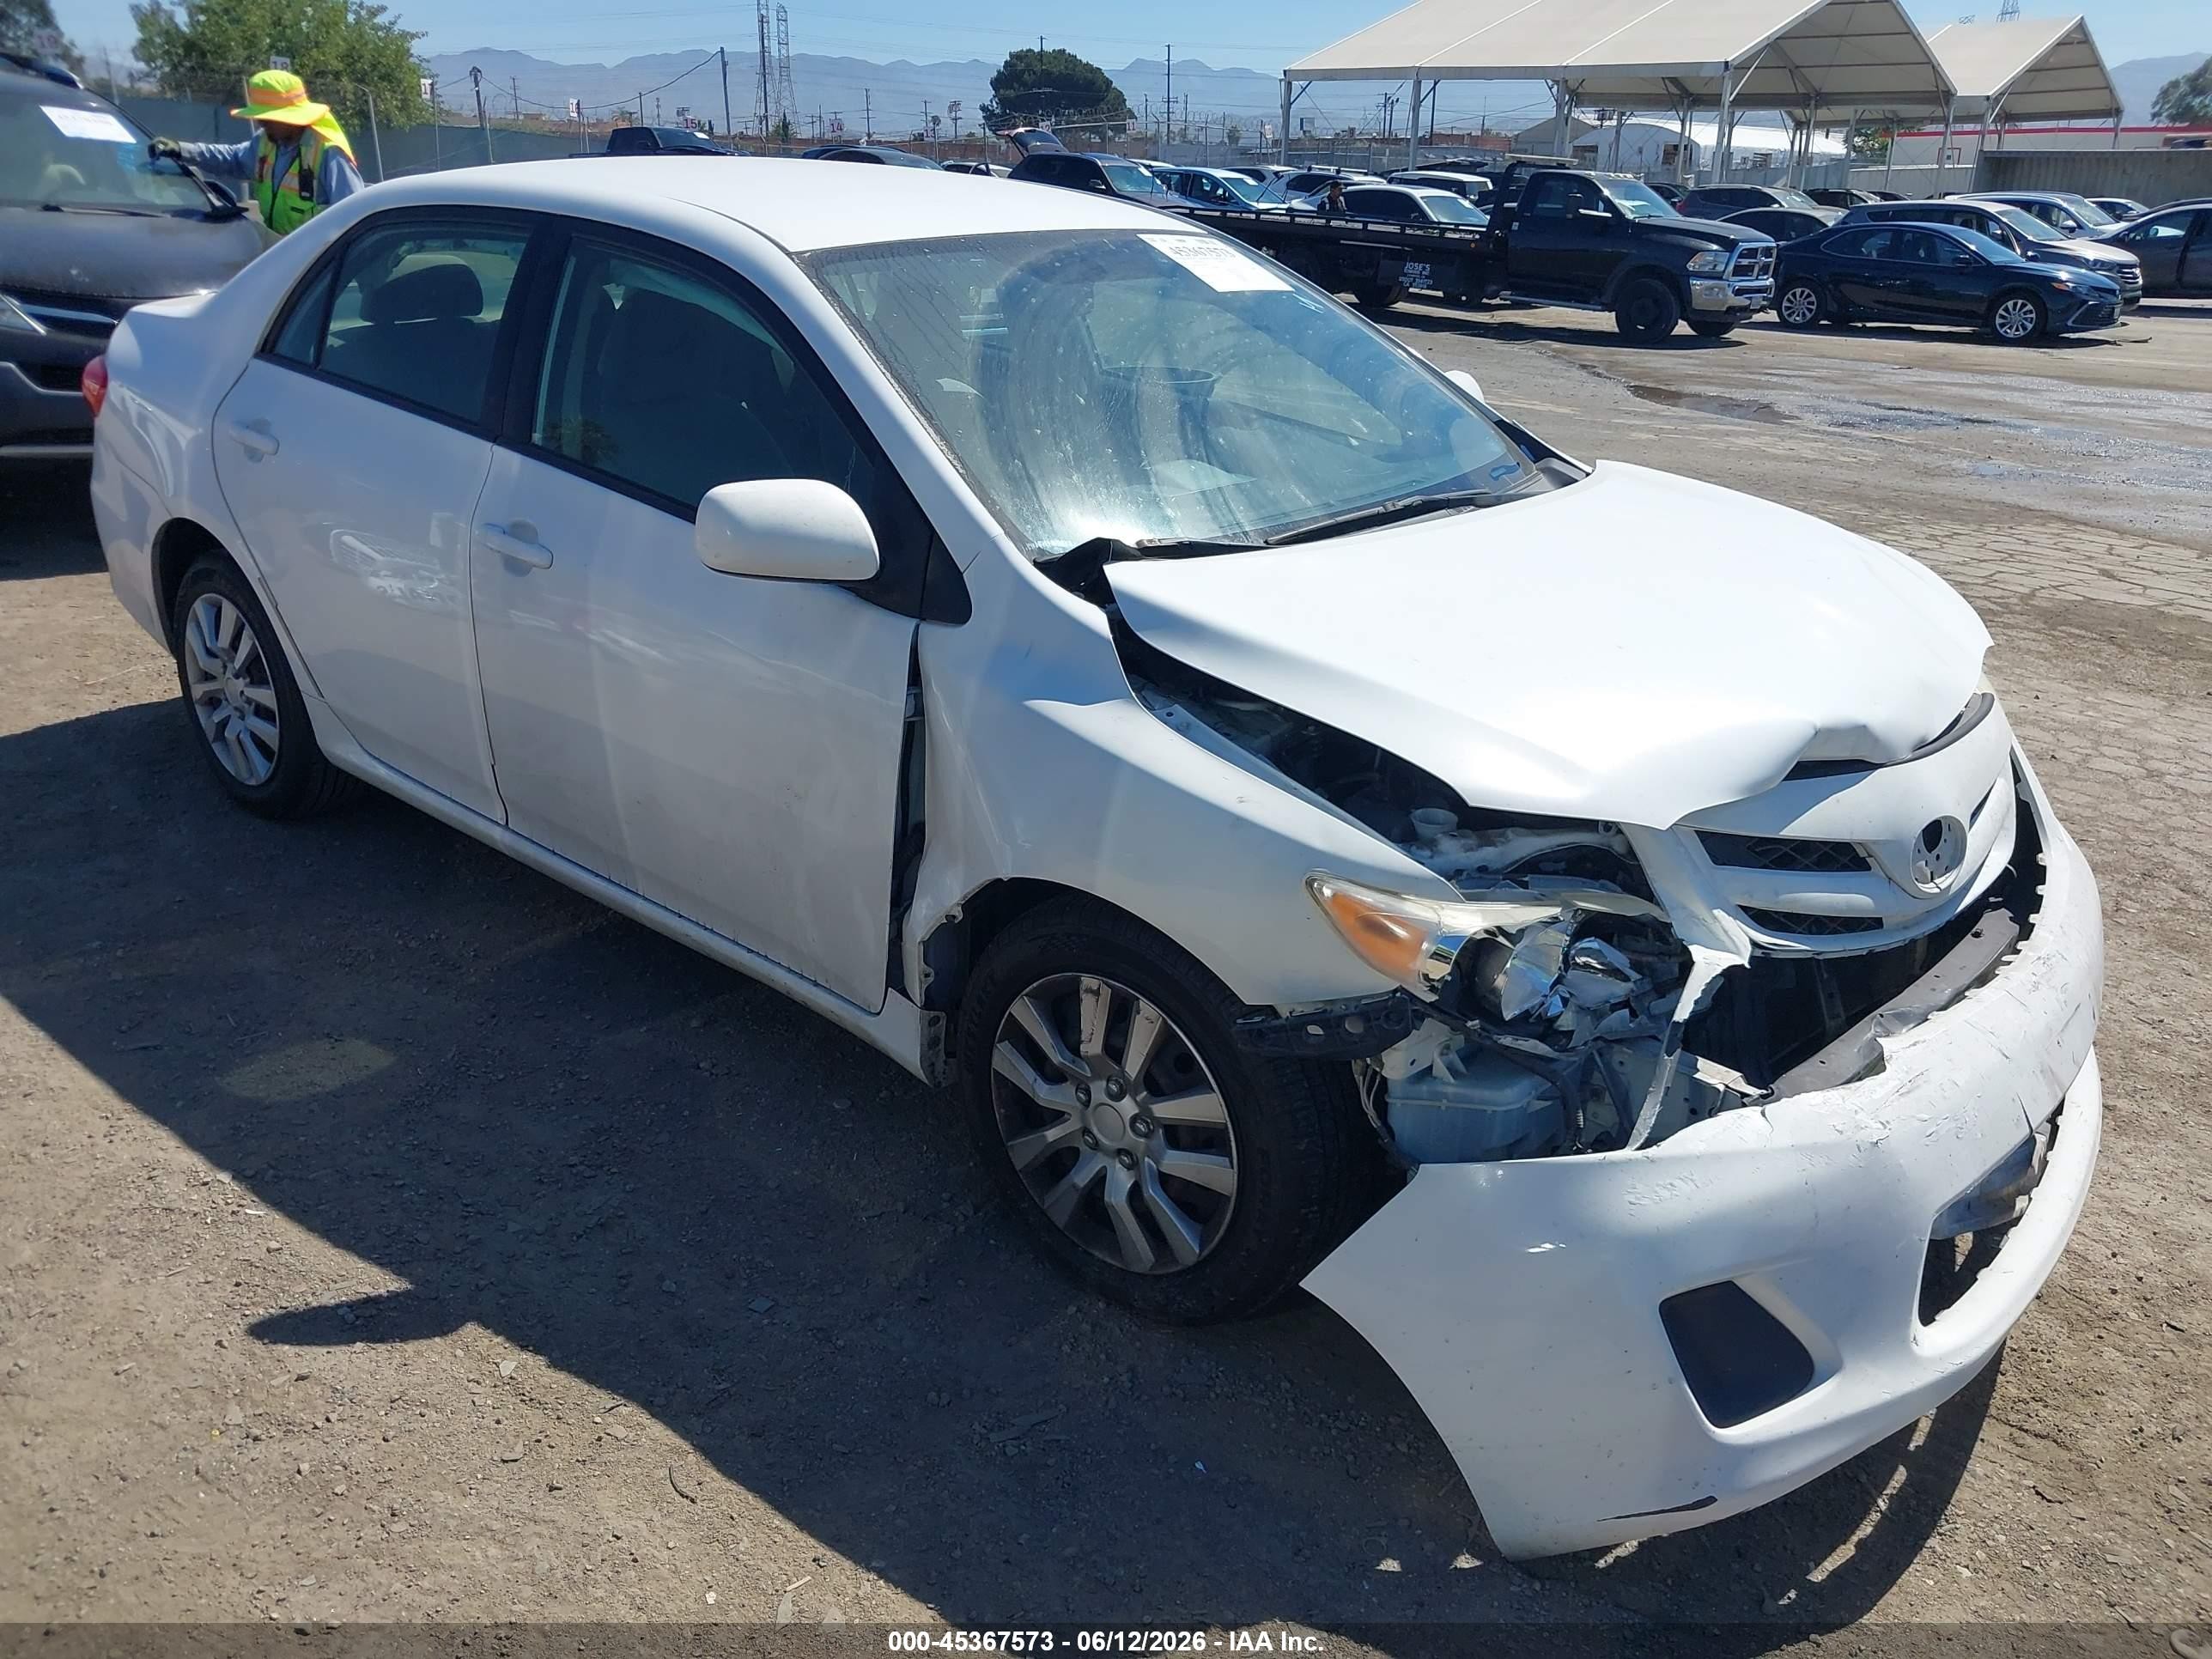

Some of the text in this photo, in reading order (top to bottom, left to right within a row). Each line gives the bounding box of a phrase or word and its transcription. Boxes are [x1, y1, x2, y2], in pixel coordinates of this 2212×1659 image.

[684, 118, 697, 129] 15
[830, 122, 843, 133] 14
[1169, 246, 1236, 258] 45367573
[1405, 262, 1430, 271] JOSE'S
